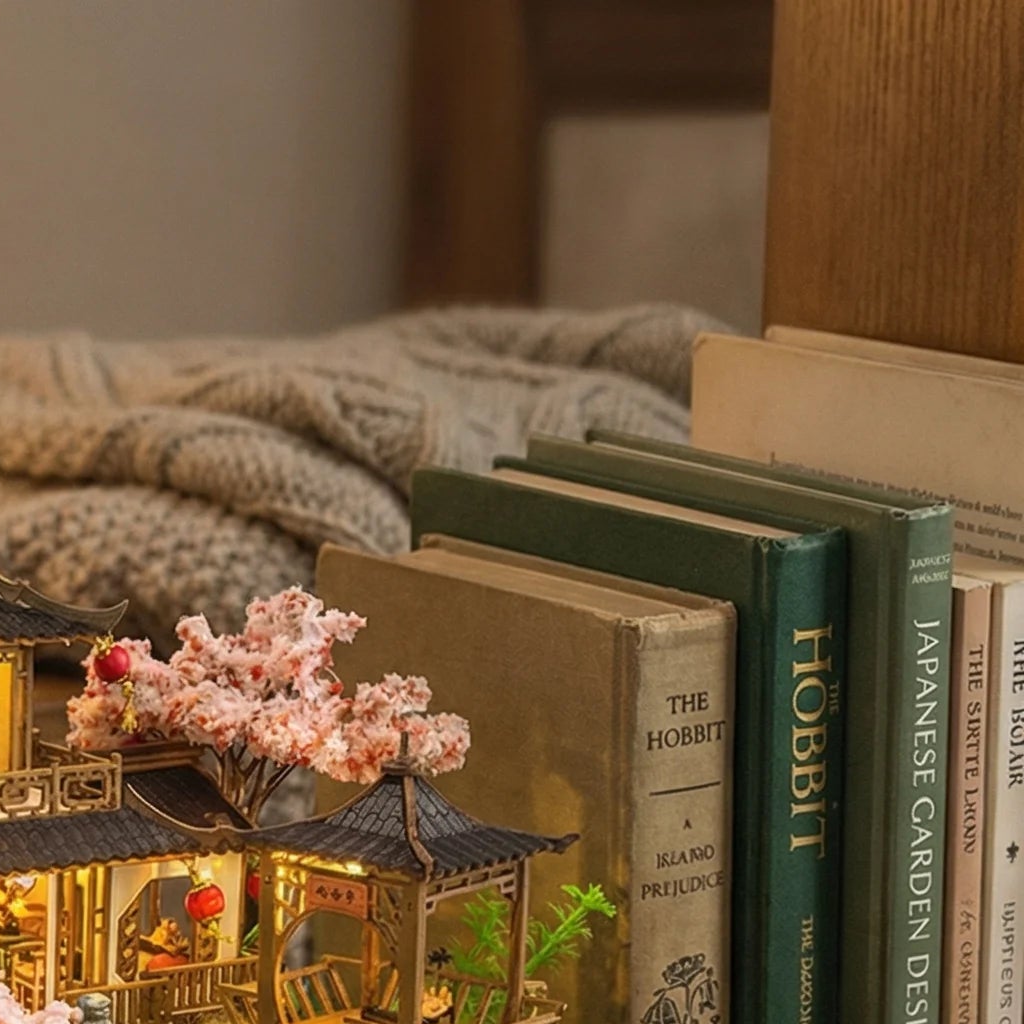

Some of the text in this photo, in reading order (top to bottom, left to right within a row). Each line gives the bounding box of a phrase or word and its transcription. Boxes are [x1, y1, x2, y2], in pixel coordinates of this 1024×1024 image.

[666, 691, 709, 715] THE
[913, 620, 941, 788] JAPANESE
[968, 644, 984, 692] THE
[646, 720, 726, 751] HOBBIT
[790, 625, 832, 860] HOBBIT
[908, 796, 936, 942] GARDEN
